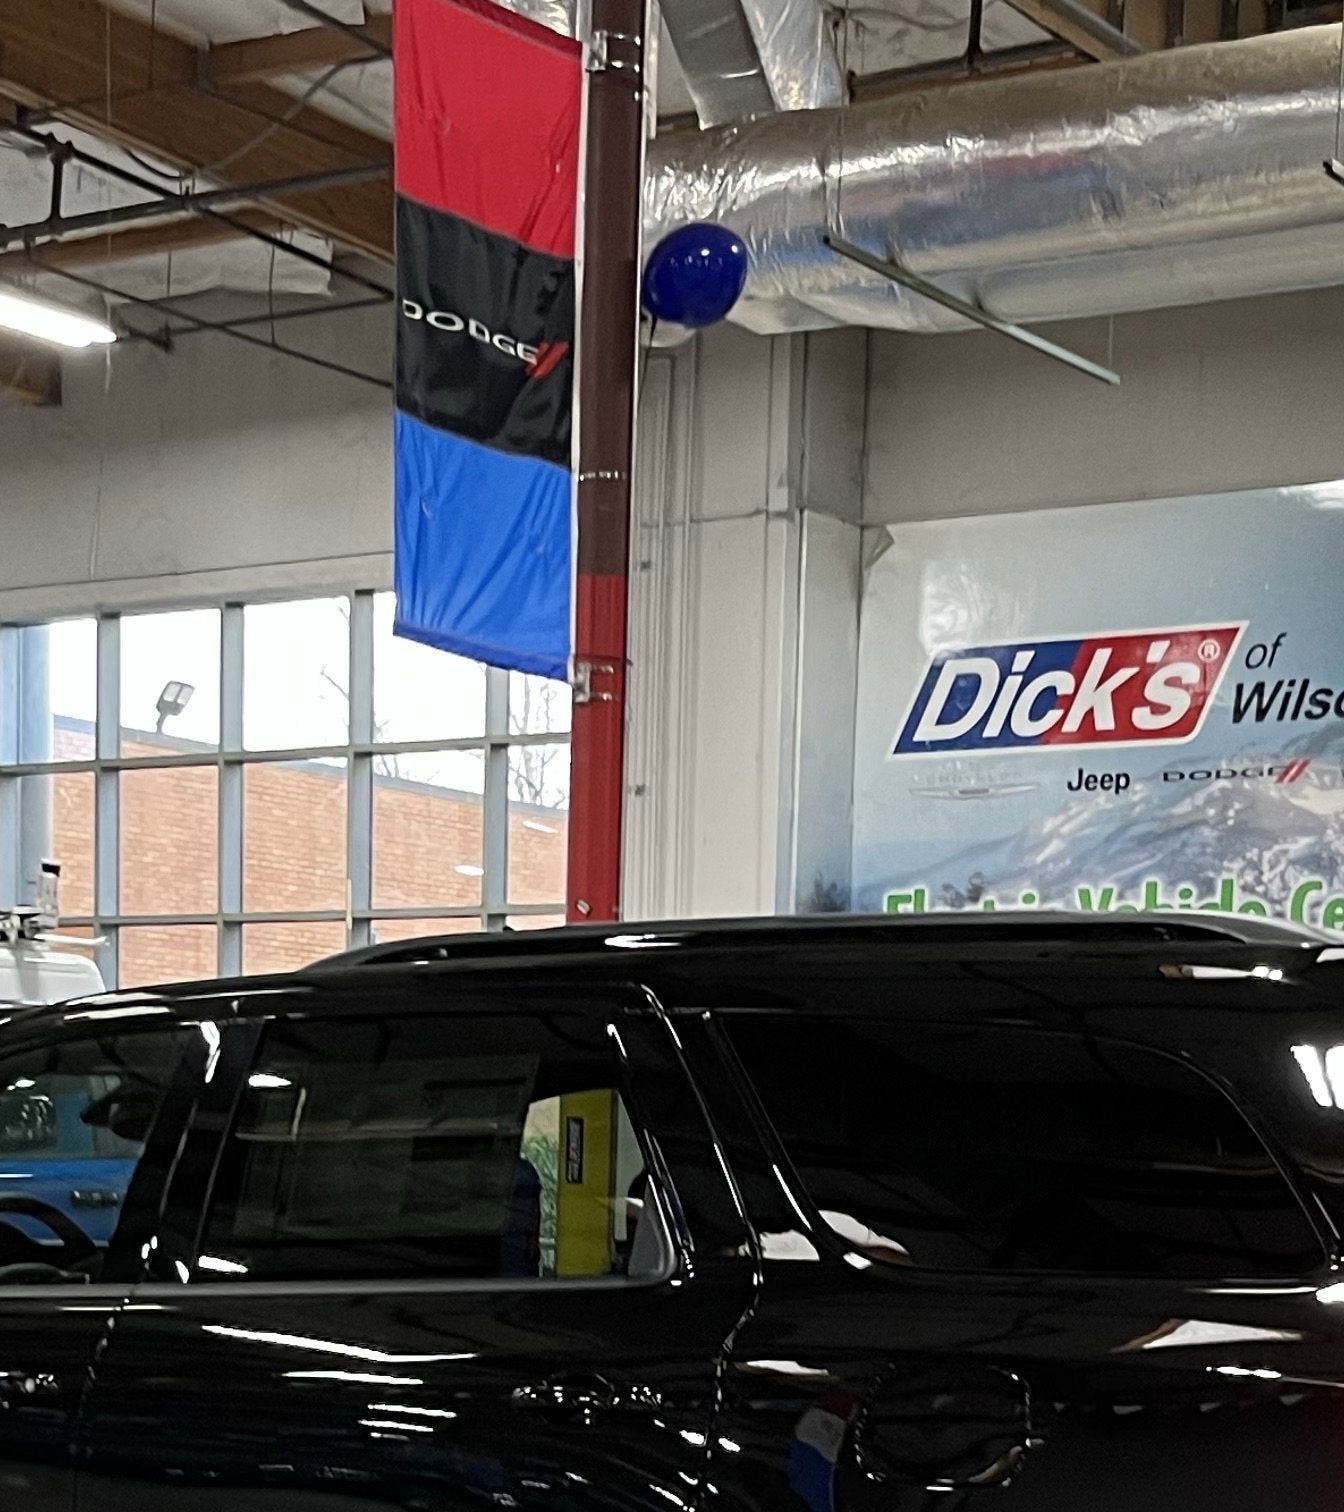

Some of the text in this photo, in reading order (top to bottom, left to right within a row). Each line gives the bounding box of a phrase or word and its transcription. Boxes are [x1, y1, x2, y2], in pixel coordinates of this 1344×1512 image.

[402, 299, 537, 365] DODGE
[1245, 633, 1287, 670] of
[913, 640, 1193, 742] Dick's
[1067, 768, 1131, 795] Jeep
